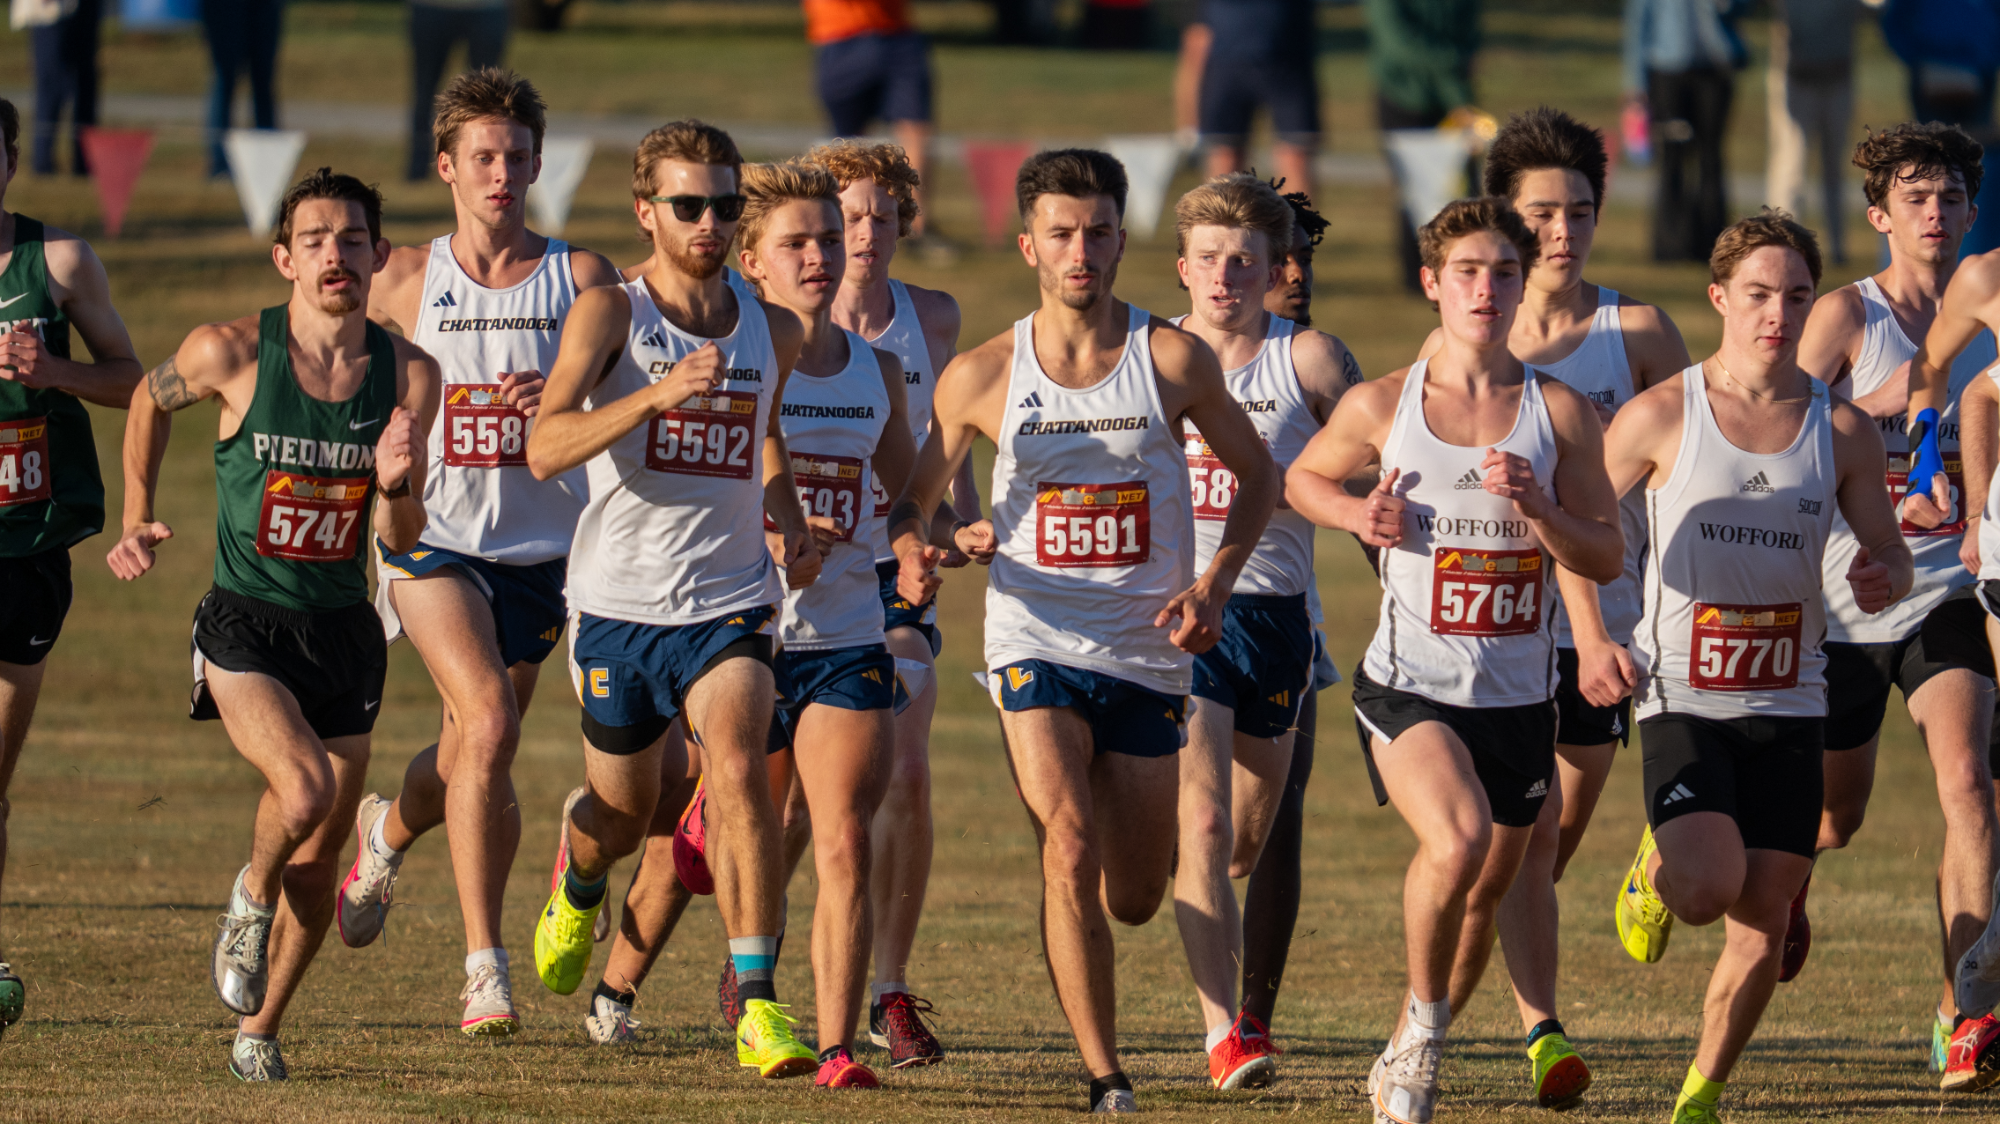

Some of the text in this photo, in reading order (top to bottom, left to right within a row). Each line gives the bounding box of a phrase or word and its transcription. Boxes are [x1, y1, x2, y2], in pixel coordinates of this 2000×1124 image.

[438, 318, 558, 332] CHATTANOOGA
[649, 361, 762, 382] CHOOGA
[734, 403, 752, 412] NET
[781, 403, 875, 419] HATTANOOGA
[22, 428, 42, 439] NET
[452, 416, 536, 455] 558
[1018, 416, 1149, 436] CHATTANOOGA
[253, 432, 377, 470] PIEDMON
[655, 419, 750, 467] 5592
[0, 450, 42, 493] 48
[841, 468, 858, 476] NET
[348, 487, 364, 498] NET
[1188, 467, 1232, 509] 58
[1454, 481, 1485, 490] adida
[1743, 483, 1775, 494] adidas
[797, 485, 855, 530] 593
[1121, 493, 1143, 502] NET
[268, 504, 358, 550] 5747
[1044, 514, 1141, 556] 5591
[1416, 514, 1529, 538] WOFFORD
[1699, 522, 1805, 550] WOFFORD
[1522, 559, 1539, 569] NET
[1440, 581, 1536, 624] 5764
[1778, 614, 1796, 624] NET
[1698, 637, 1794, 679] 5770
[589, 667, 610, 698] C
